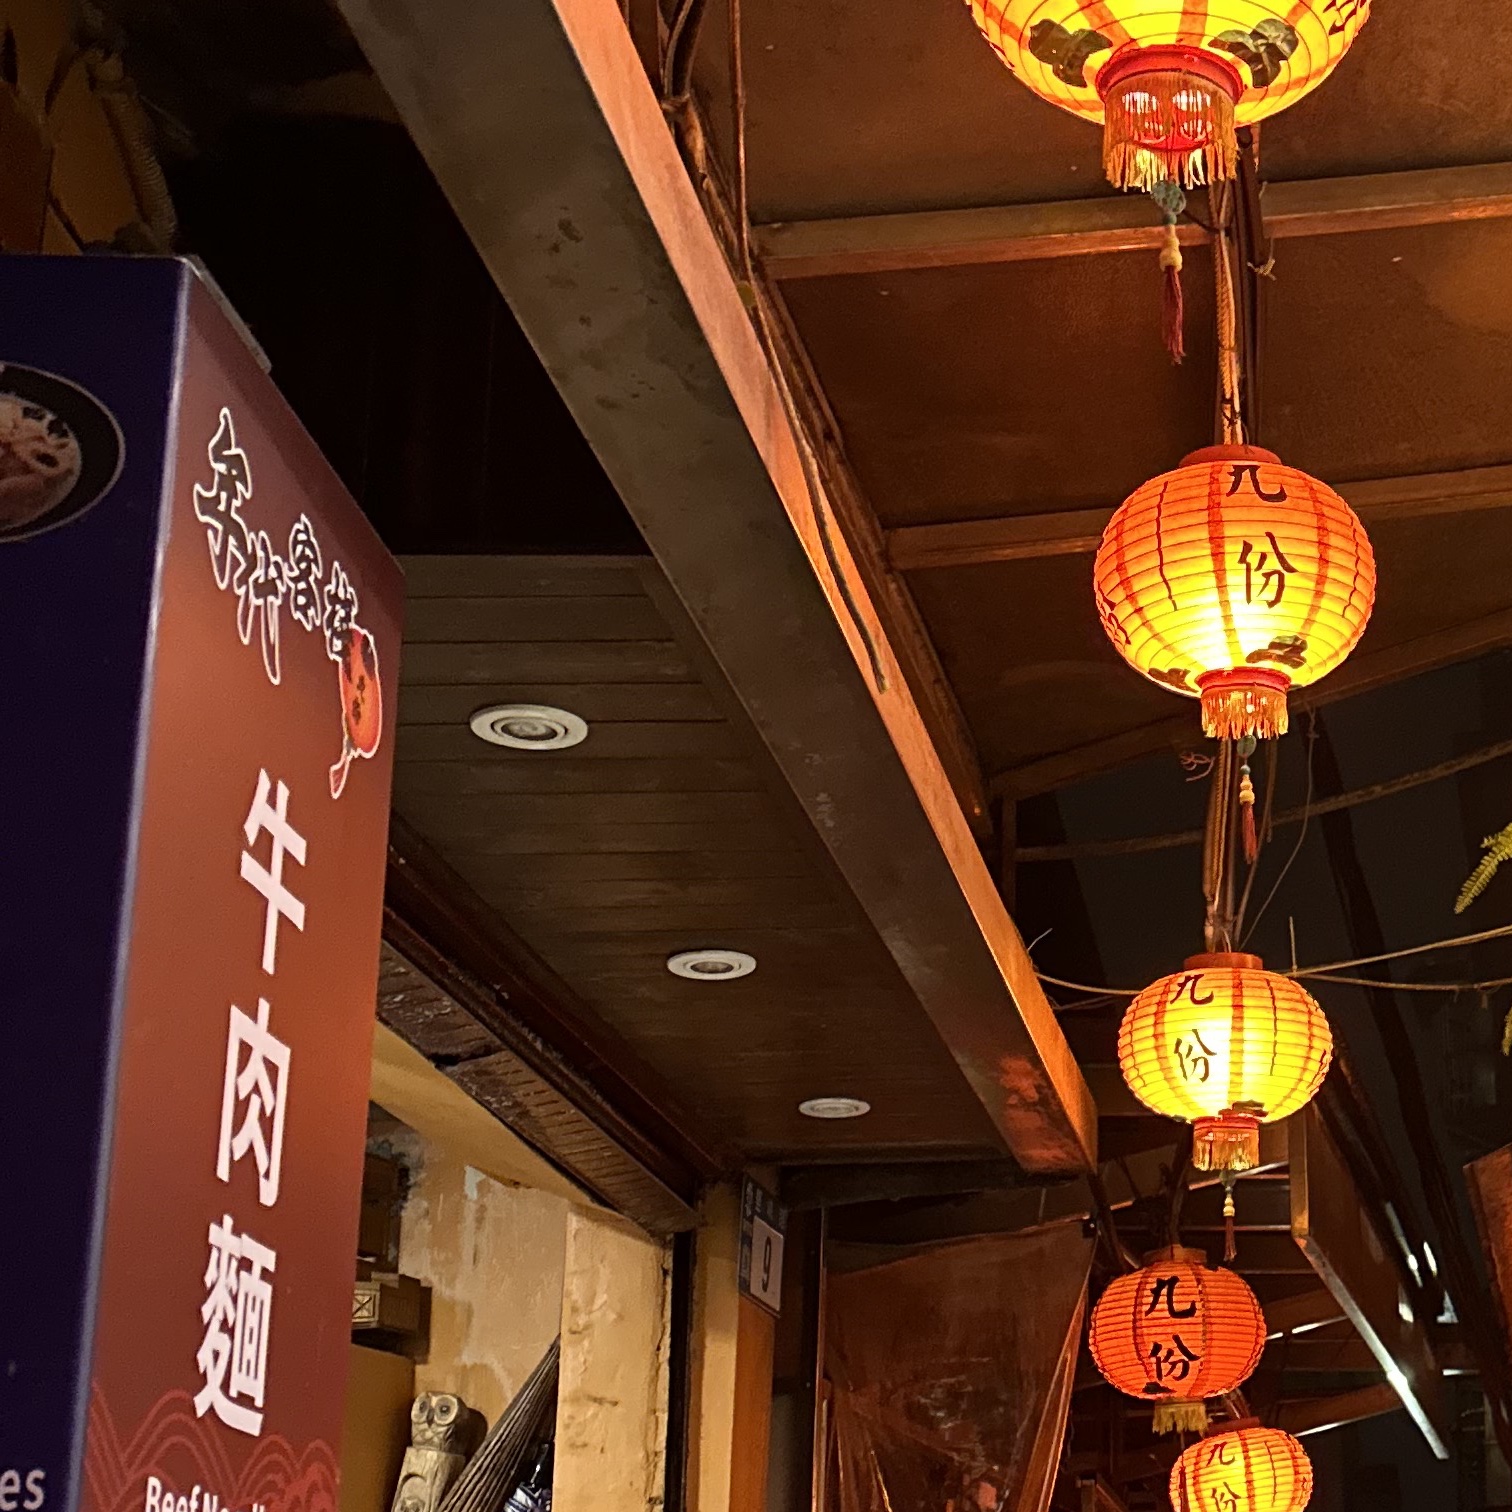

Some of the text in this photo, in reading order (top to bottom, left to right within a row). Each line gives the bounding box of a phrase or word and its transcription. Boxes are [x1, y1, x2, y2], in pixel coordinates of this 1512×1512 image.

[1226, 464, 1297, 609] 九份
[1170, 973, 1217, 1084] 九份
[193, 768, 306, 1436] 牛肉麵
[1144, 1276, 1200, 1382] 九份
